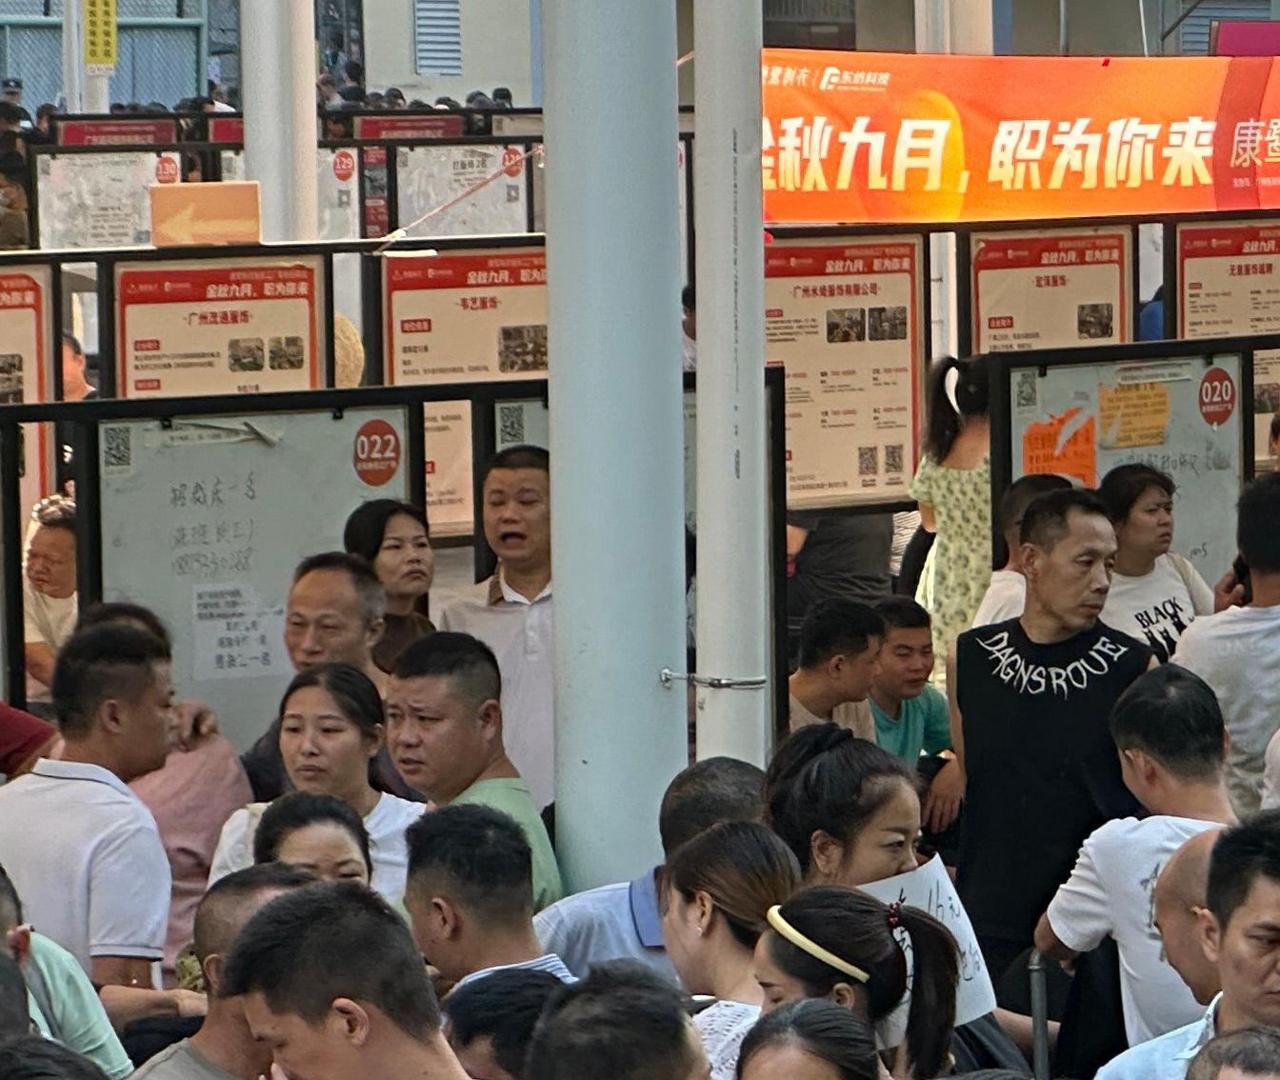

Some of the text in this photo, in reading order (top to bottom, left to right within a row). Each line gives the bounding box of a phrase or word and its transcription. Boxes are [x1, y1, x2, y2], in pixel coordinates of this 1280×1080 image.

[1202, 380, 1232, 402] 020
[356, 435, 396, 459] 022
[1134, 597, 1184, 629] BLACK
